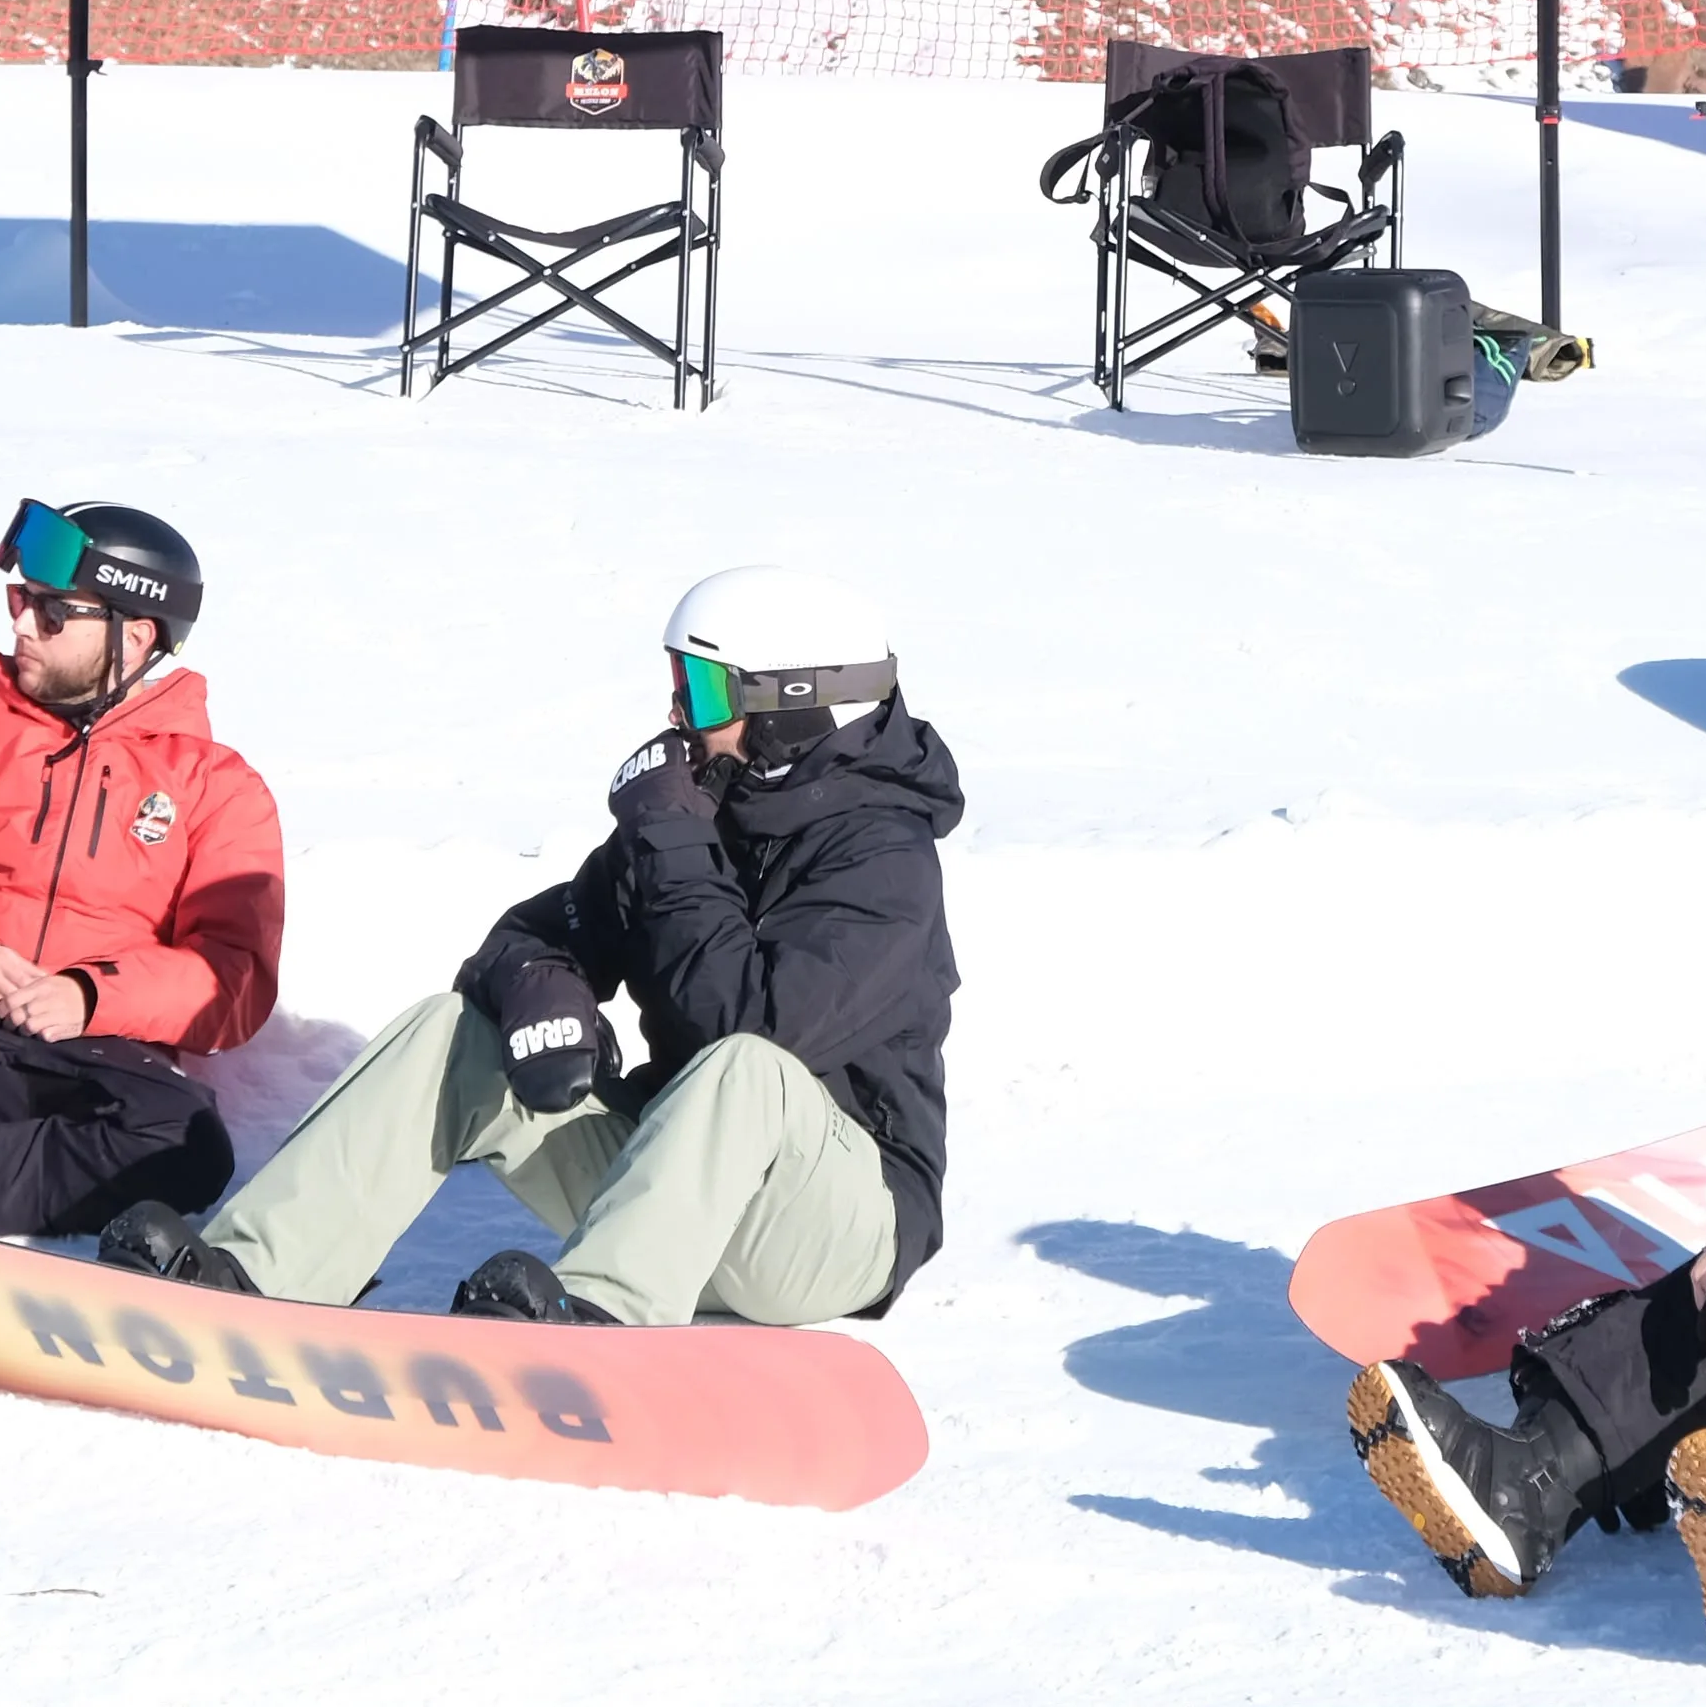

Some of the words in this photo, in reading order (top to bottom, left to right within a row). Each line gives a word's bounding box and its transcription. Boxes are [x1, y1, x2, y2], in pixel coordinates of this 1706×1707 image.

[95, 564, 168, 602] SMITH
[509, 1017, 582, 1060] GRAB
[7, 1283, 613, 1445] BURTON
